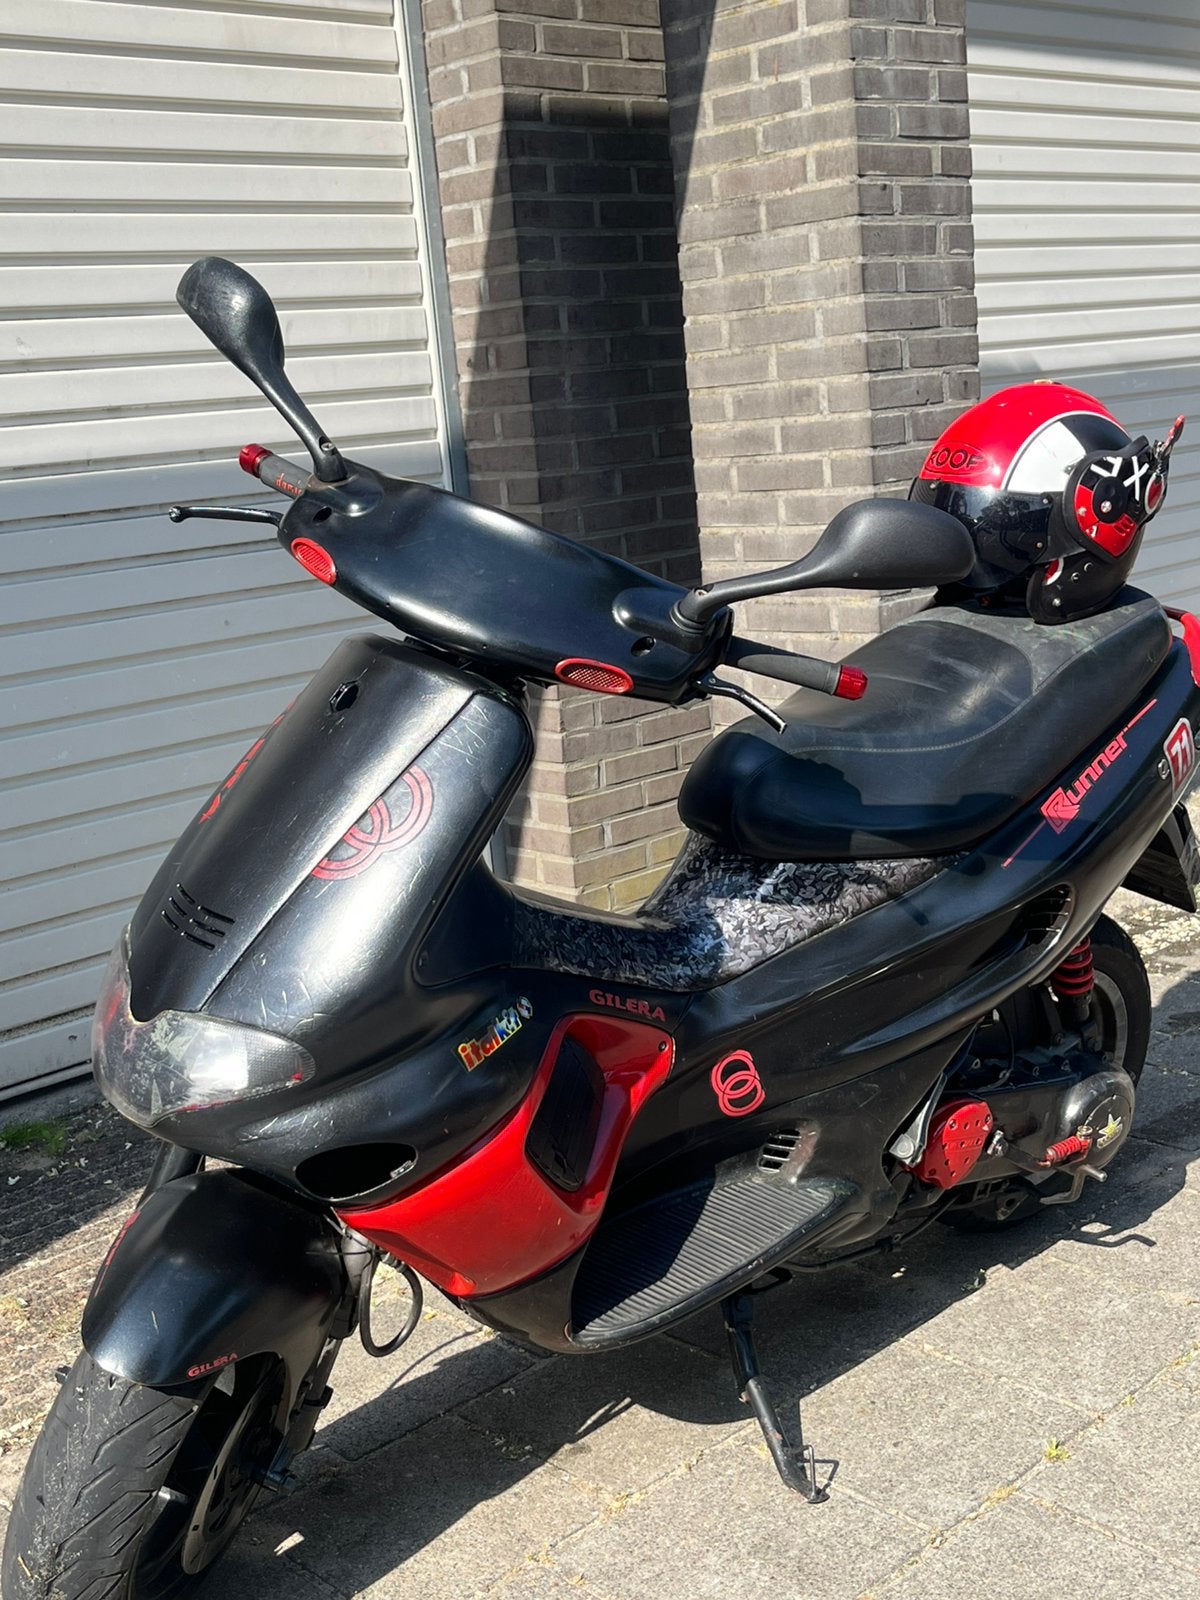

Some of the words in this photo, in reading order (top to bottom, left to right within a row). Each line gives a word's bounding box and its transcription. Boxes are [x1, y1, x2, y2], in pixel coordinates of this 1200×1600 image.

[928, 447, 984, 470] ROOF
[1040, 730, 1128, 835] Runner
[588, 989, 666, 1022] GILERA
[188, 1352, 238, 1377] GILERA
